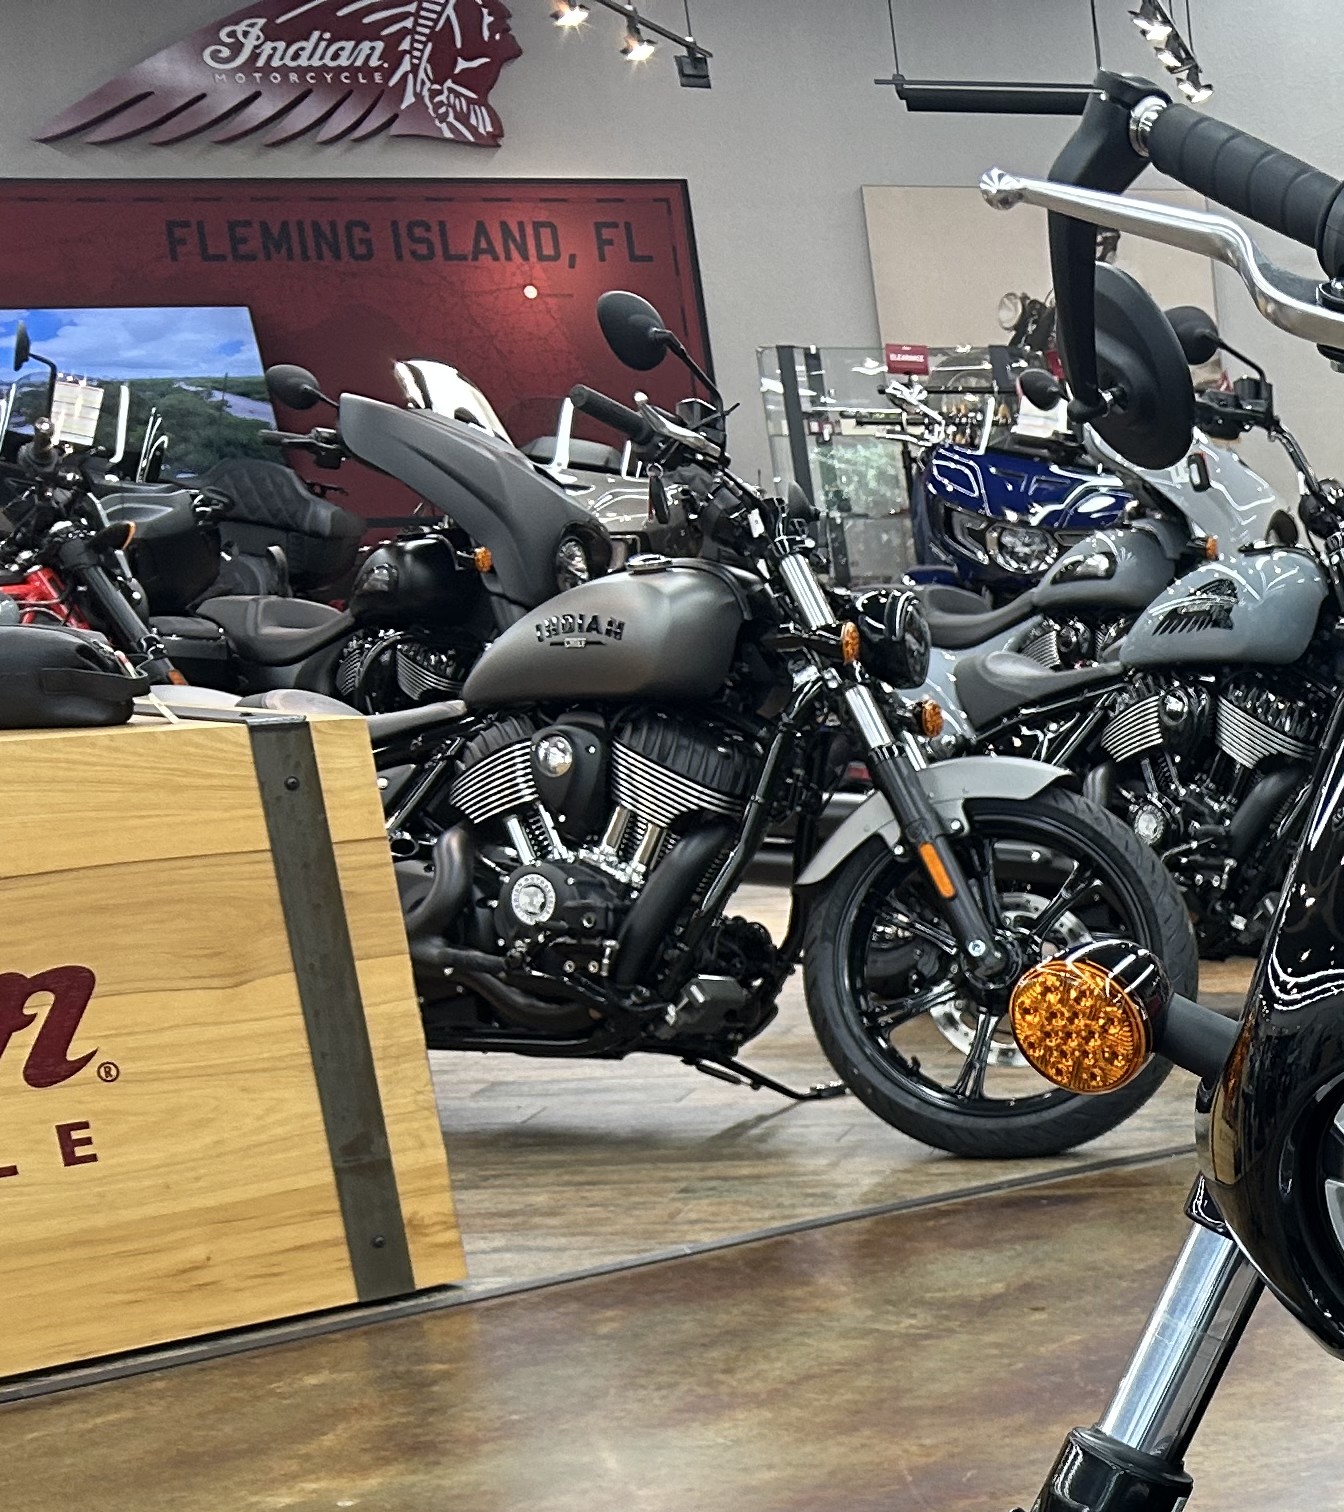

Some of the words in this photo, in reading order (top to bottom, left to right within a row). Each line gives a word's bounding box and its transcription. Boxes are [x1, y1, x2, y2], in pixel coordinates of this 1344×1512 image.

[203, 18, 385, 69] Indian
[214, 72, 385, 84] MOTORCYCLE
[165, 219, 377, 263] FLEMING
[390, 220, 577, 269] ISLAND,
[593, 220, 654, 263] FL
[535, 613, 626, 642] INDIAN
